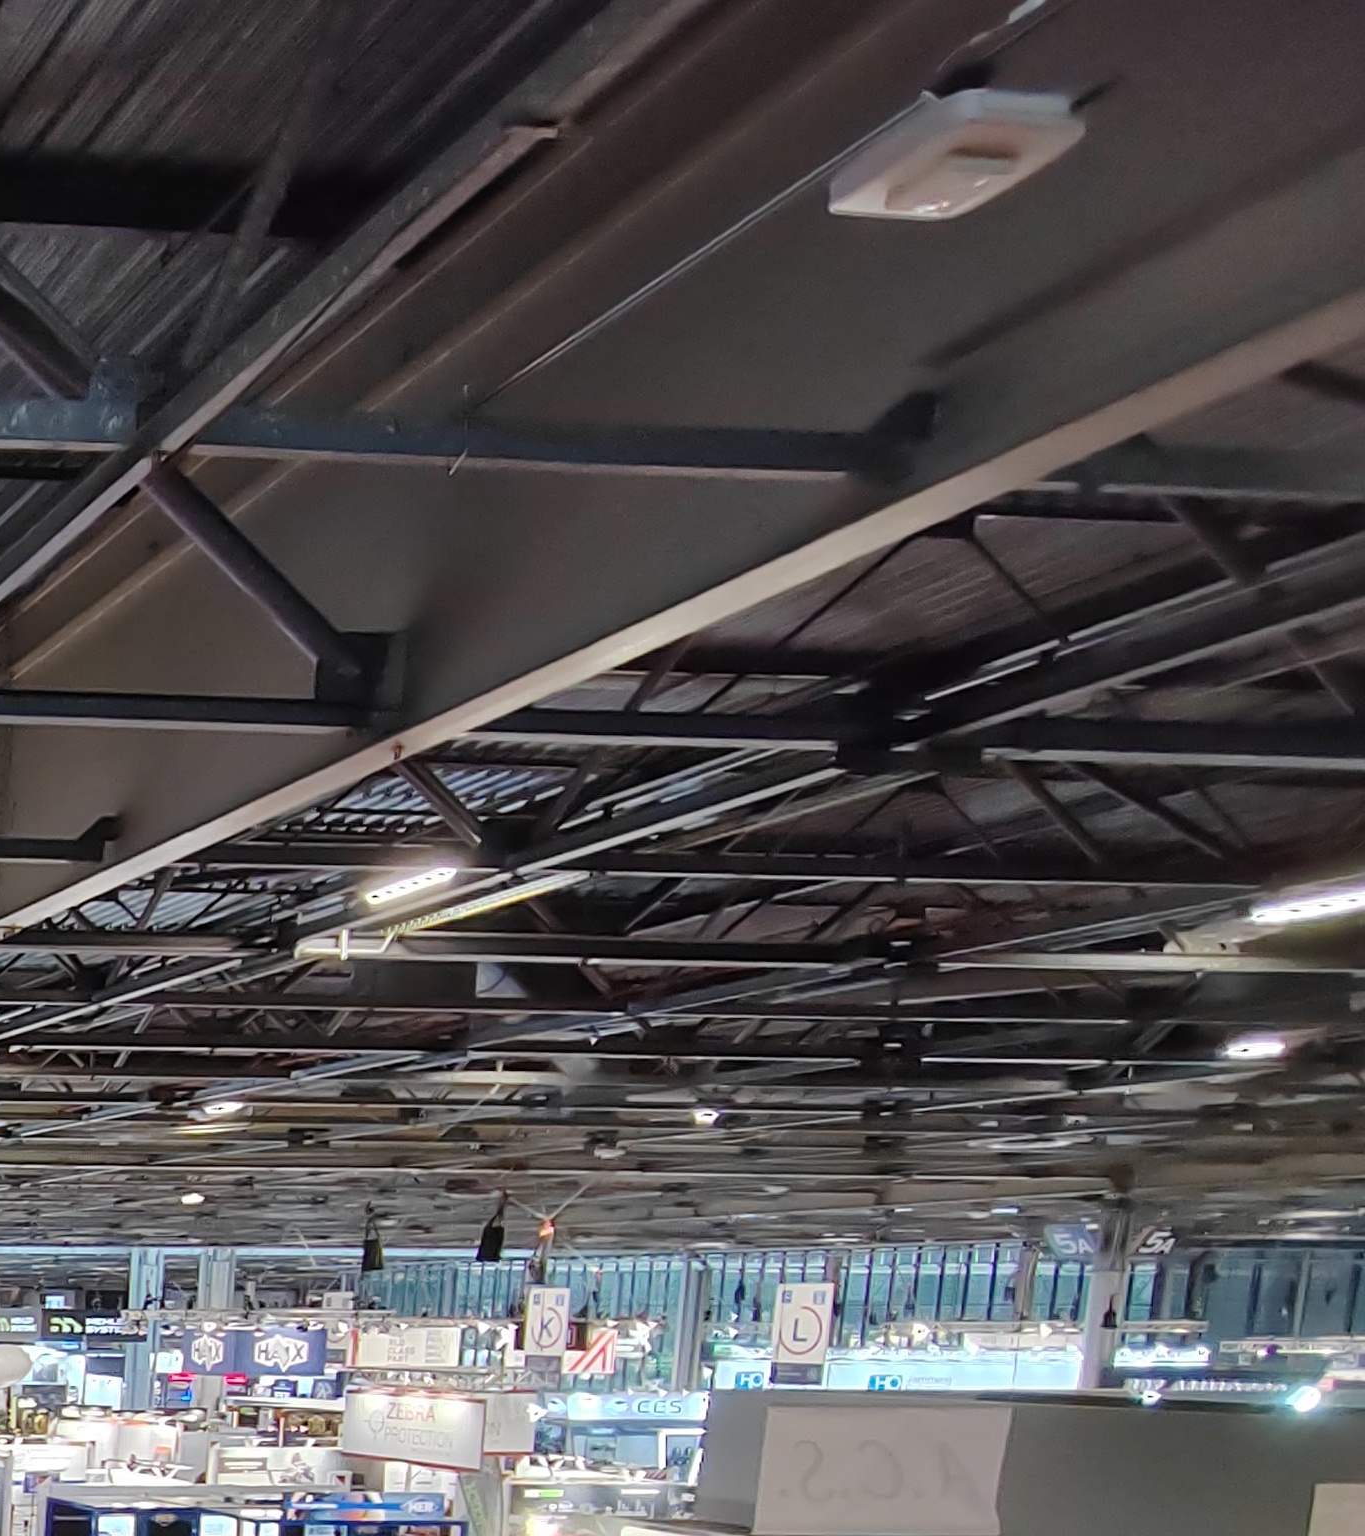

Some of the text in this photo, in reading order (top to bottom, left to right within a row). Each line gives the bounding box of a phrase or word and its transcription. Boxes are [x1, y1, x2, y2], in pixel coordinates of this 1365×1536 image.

[540, 1317, 555, 1338] K
[792, 1317, 807, 1342] L
[386, 1402, 436, 1422] ZEBRA
[384, 1426, 455, 1449] PROTECTION
